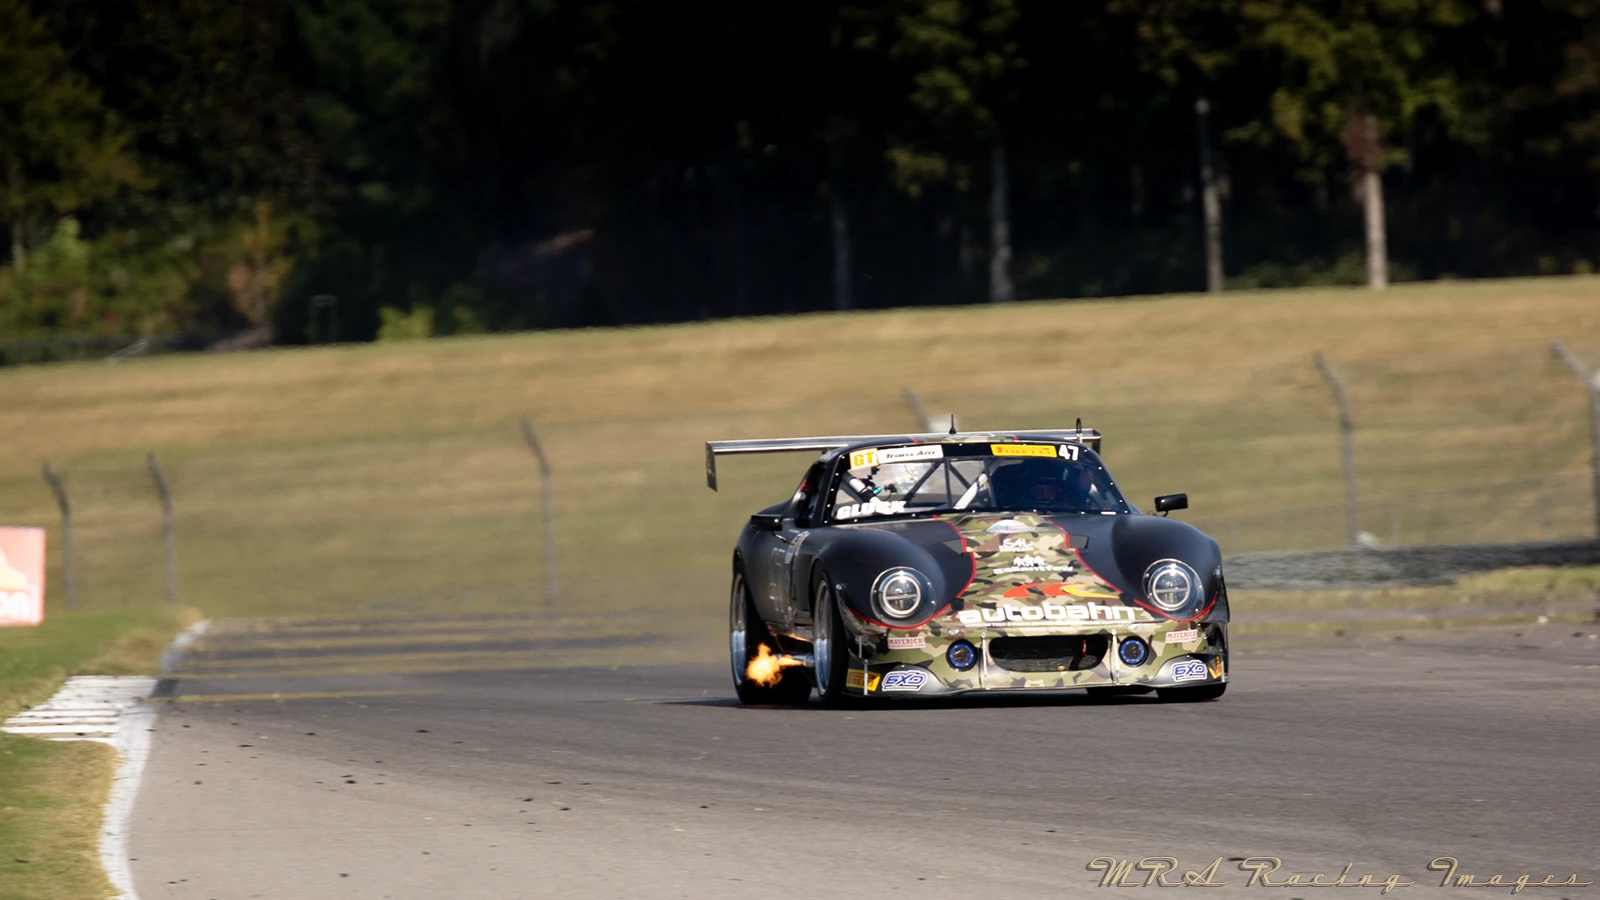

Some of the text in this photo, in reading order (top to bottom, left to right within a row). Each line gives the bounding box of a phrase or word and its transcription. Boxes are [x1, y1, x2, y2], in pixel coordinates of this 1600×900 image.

[853, 450, 875, 467] GT
[1058, 444, 1079, 461] 47
[958, 602, 1135, 624] autobahn
[1167, 631, 1197, 639] MAVERICK
